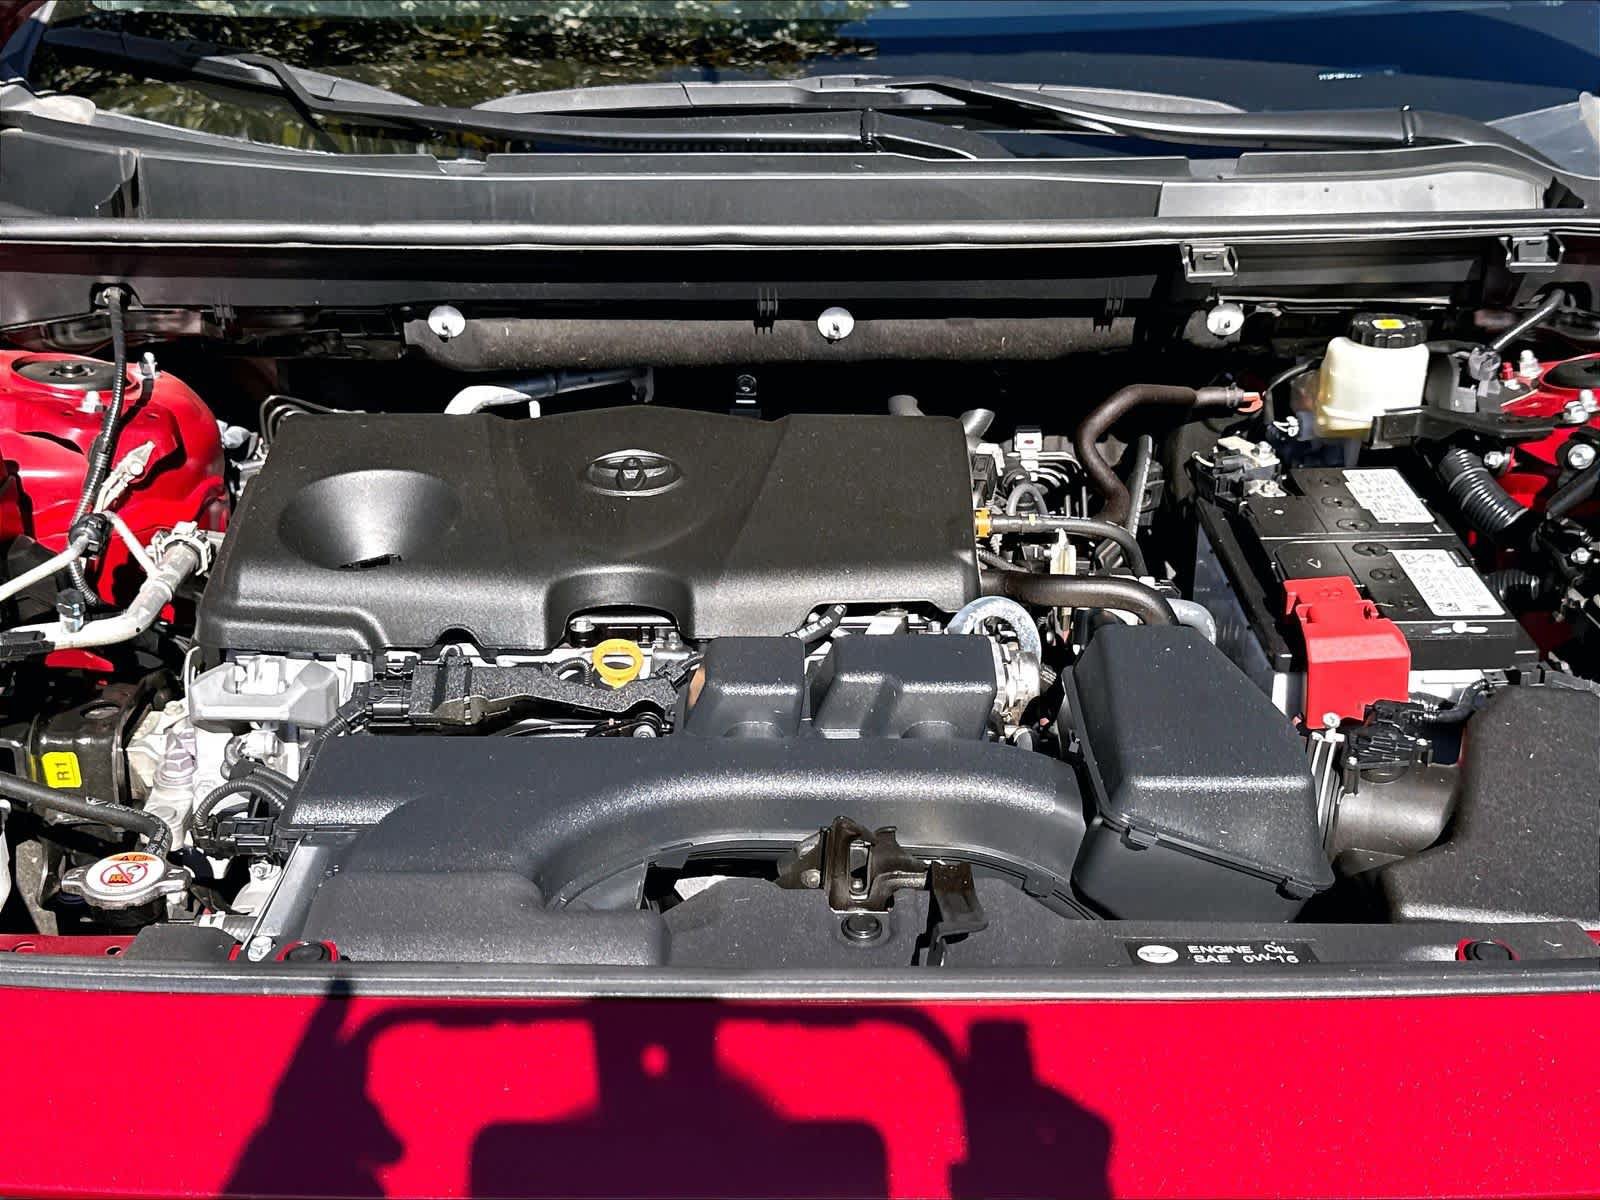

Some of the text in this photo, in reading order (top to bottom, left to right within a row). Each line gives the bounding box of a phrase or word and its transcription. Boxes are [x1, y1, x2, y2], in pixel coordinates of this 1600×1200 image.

[55, 762, 71, 780] R1
[1187, 943, 1294, 954] ENGINE OIL
[1193, 954, 1231, 963] SAE
